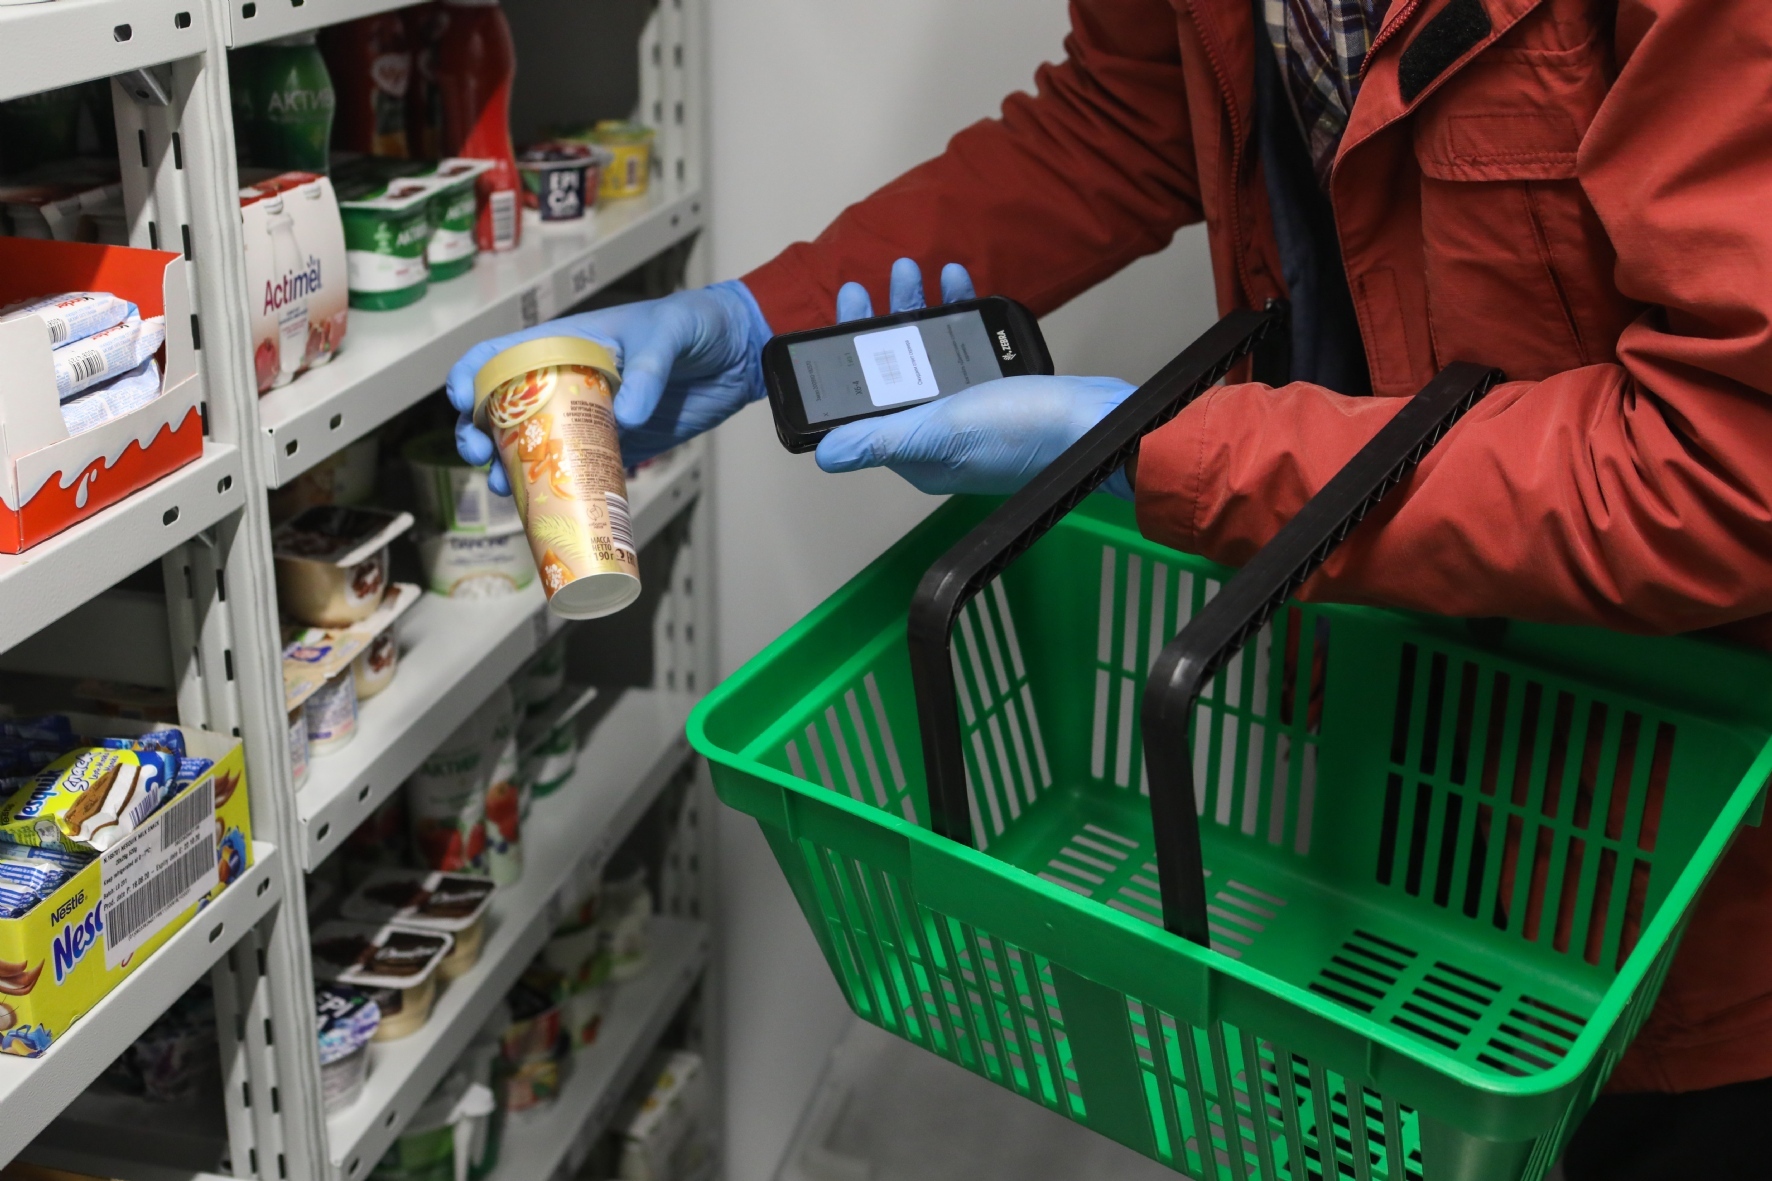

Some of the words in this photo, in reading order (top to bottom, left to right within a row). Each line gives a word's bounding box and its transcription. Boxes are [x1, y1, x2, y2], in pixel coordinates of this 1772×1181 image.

[263, 255, 322, 315] Actimel
[997, 329, 1011, 351] ZEBRA
[591, 536, 611, 544] МАССА
[592, 544, 612, 552] НЕТТО
[594, 551, 610, 561] 190
[62, 752, 99, 793] Snack
[51, 889, 86, 927] Nestlé
